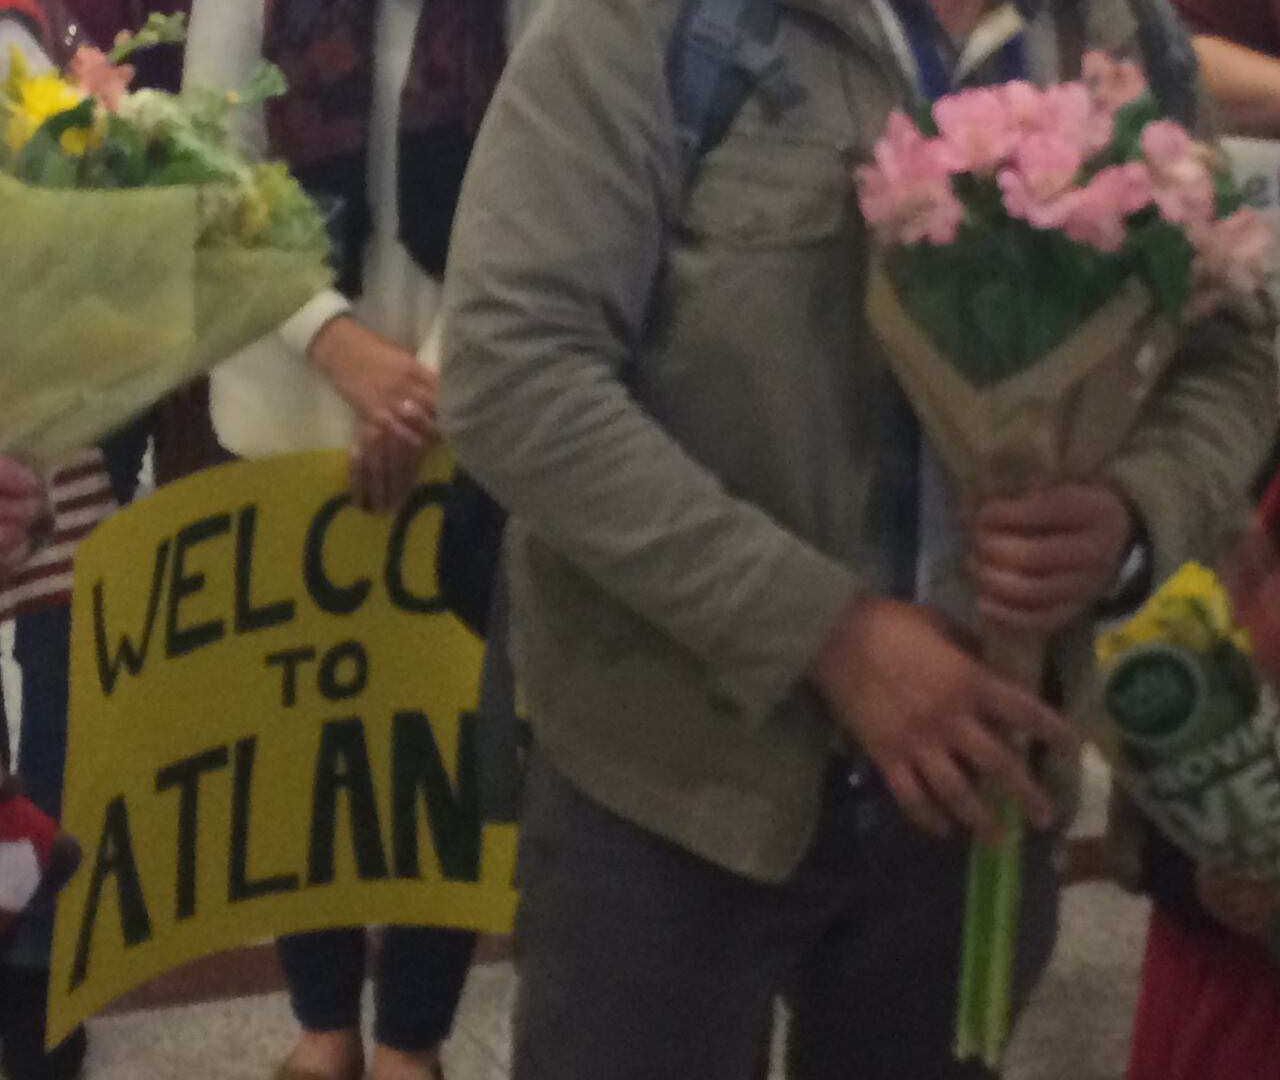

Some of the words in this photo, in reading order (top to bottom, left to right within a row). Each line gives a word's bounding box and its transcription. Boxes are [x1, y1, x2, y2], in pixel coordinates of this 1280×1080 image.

[91, 479, 455, 697] WELCO
[265, 640, 368, 709] TO
[67, 709, 482, 995] ATLAN
